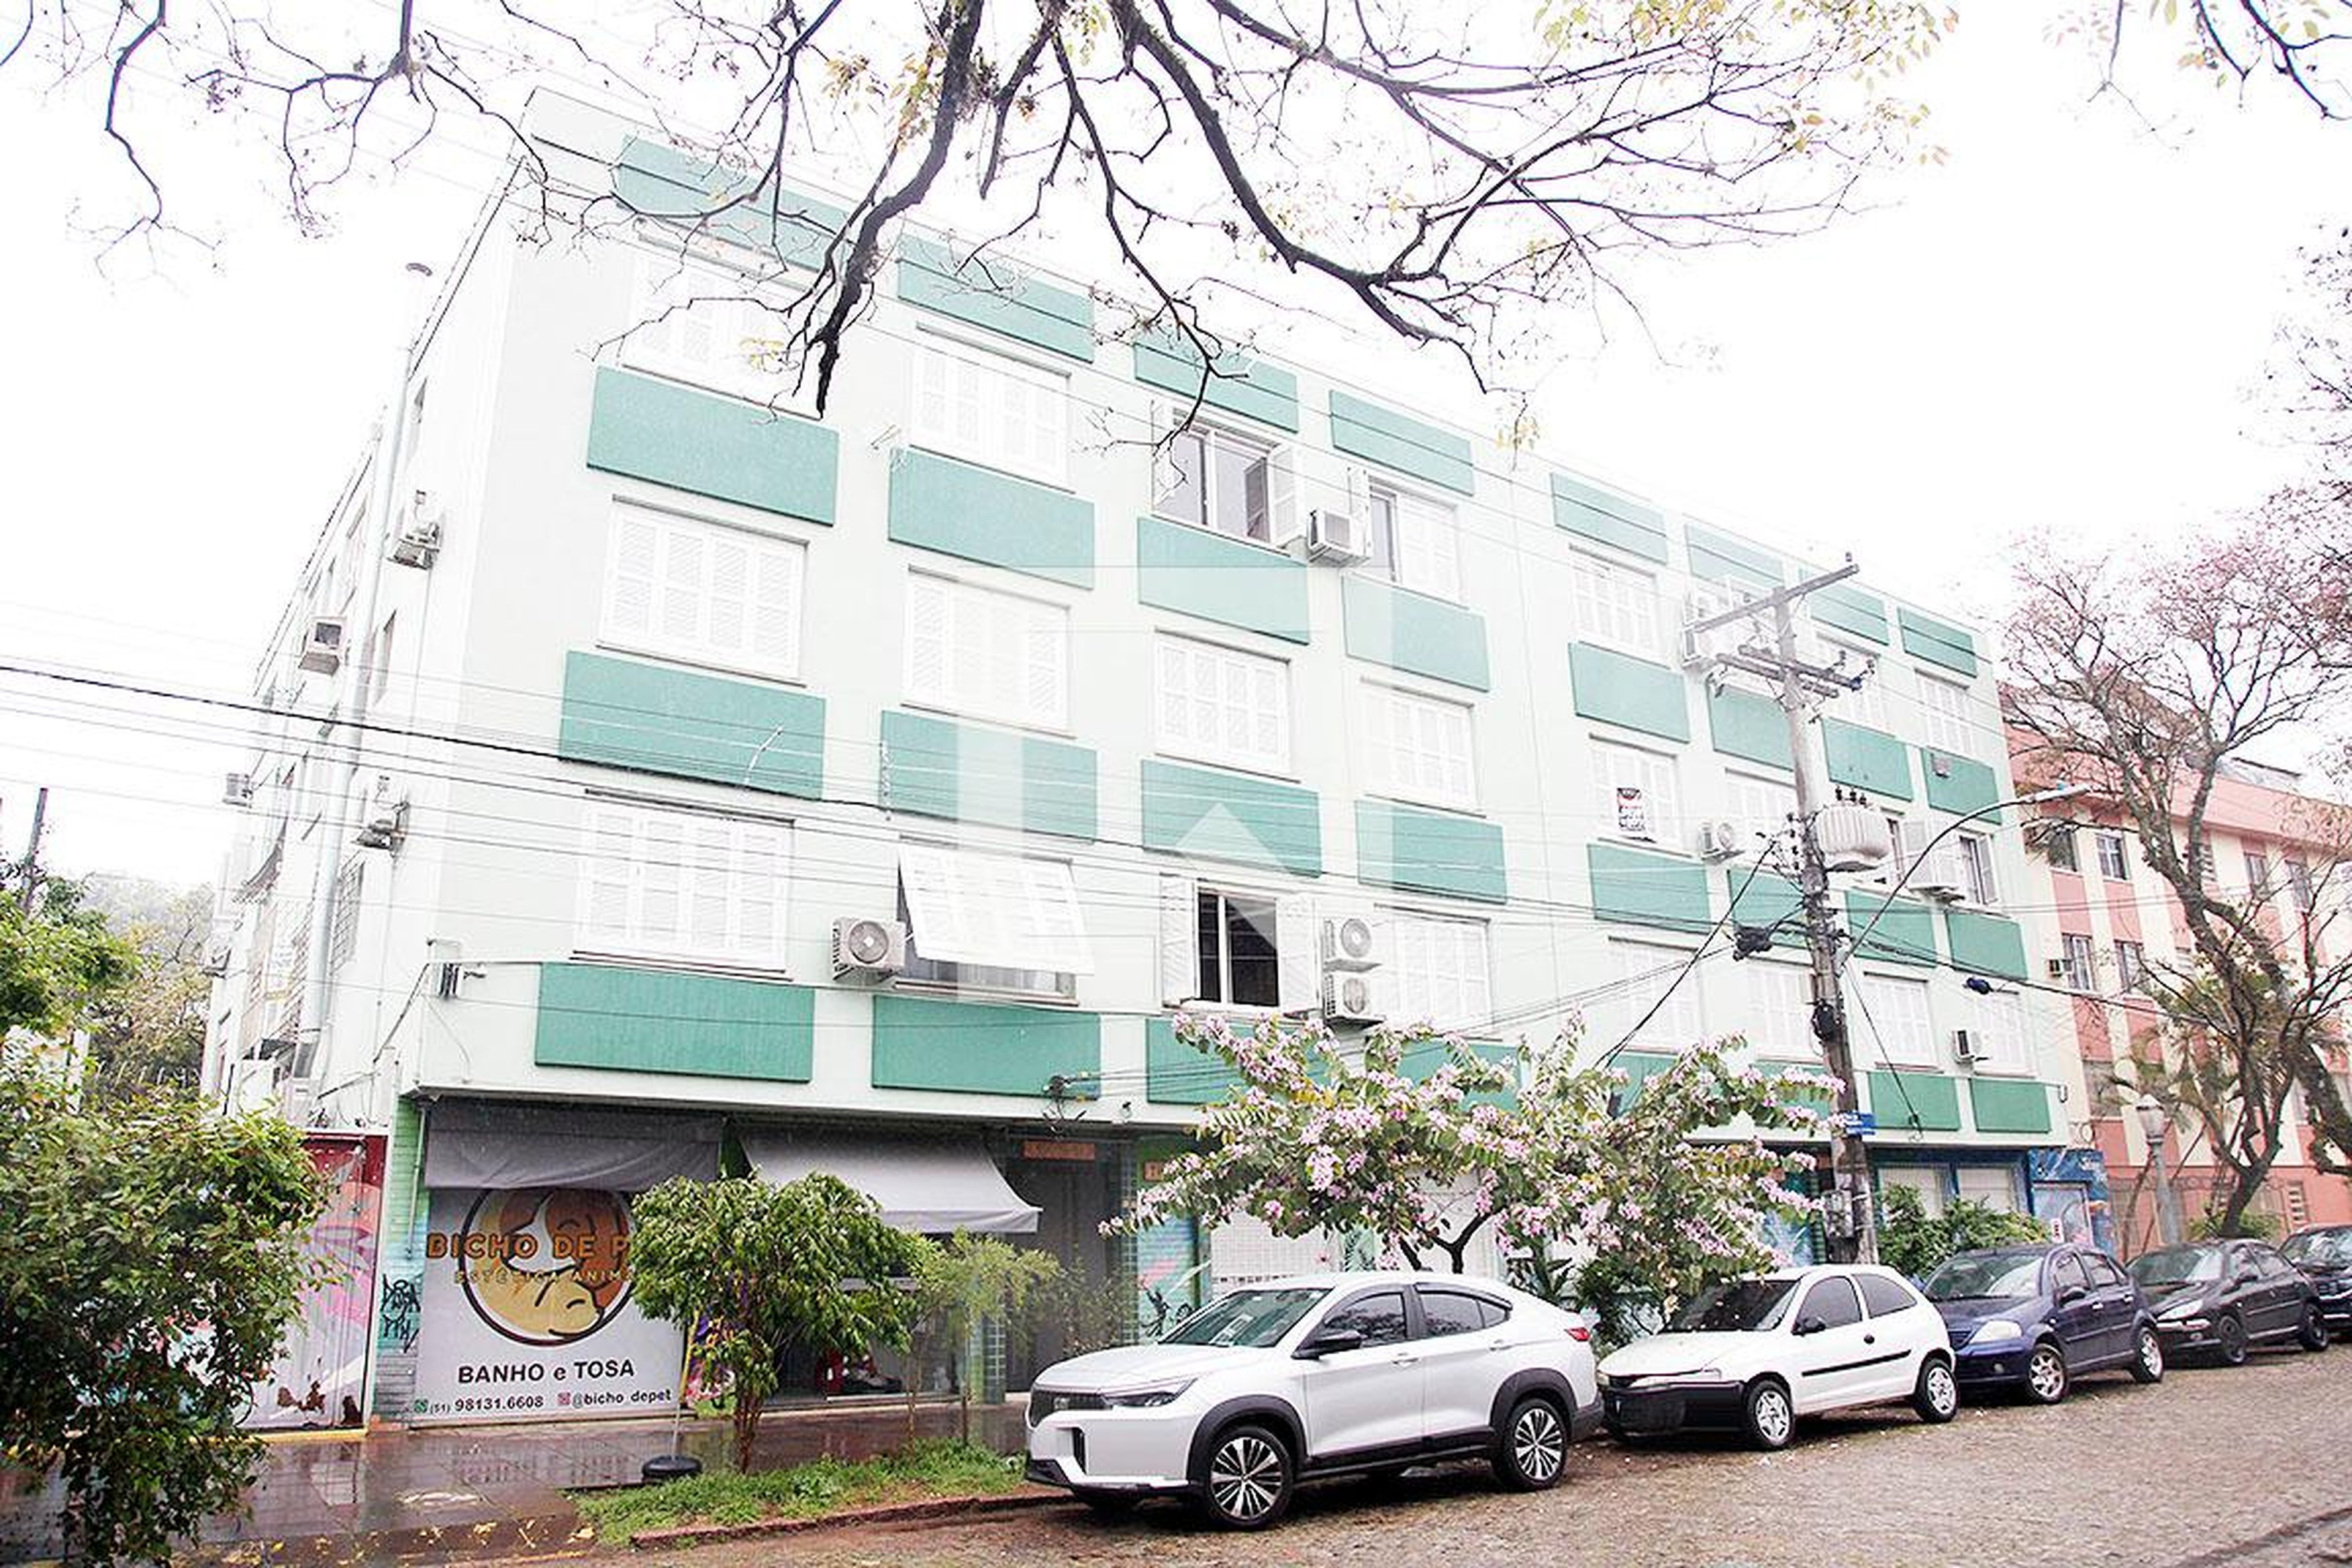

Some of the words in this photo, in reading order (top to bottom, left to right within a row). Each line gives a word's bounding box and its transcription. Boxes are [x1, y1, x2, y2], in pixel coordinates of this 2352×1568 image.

[426, 1232, 538, 1259] BICHO
[553, 1234, 596, 1259] DE
[572, 1268, 635, 1283] ANIMA
[458, 1363, 545, 1383] BANHO
[553, 1366, 566, 1381] e
[573, 1359, 635, 1379] TOSA
[430, 1403, 450, 1414] (51)
[454, 1395, 545, 1411] 98131.6608
